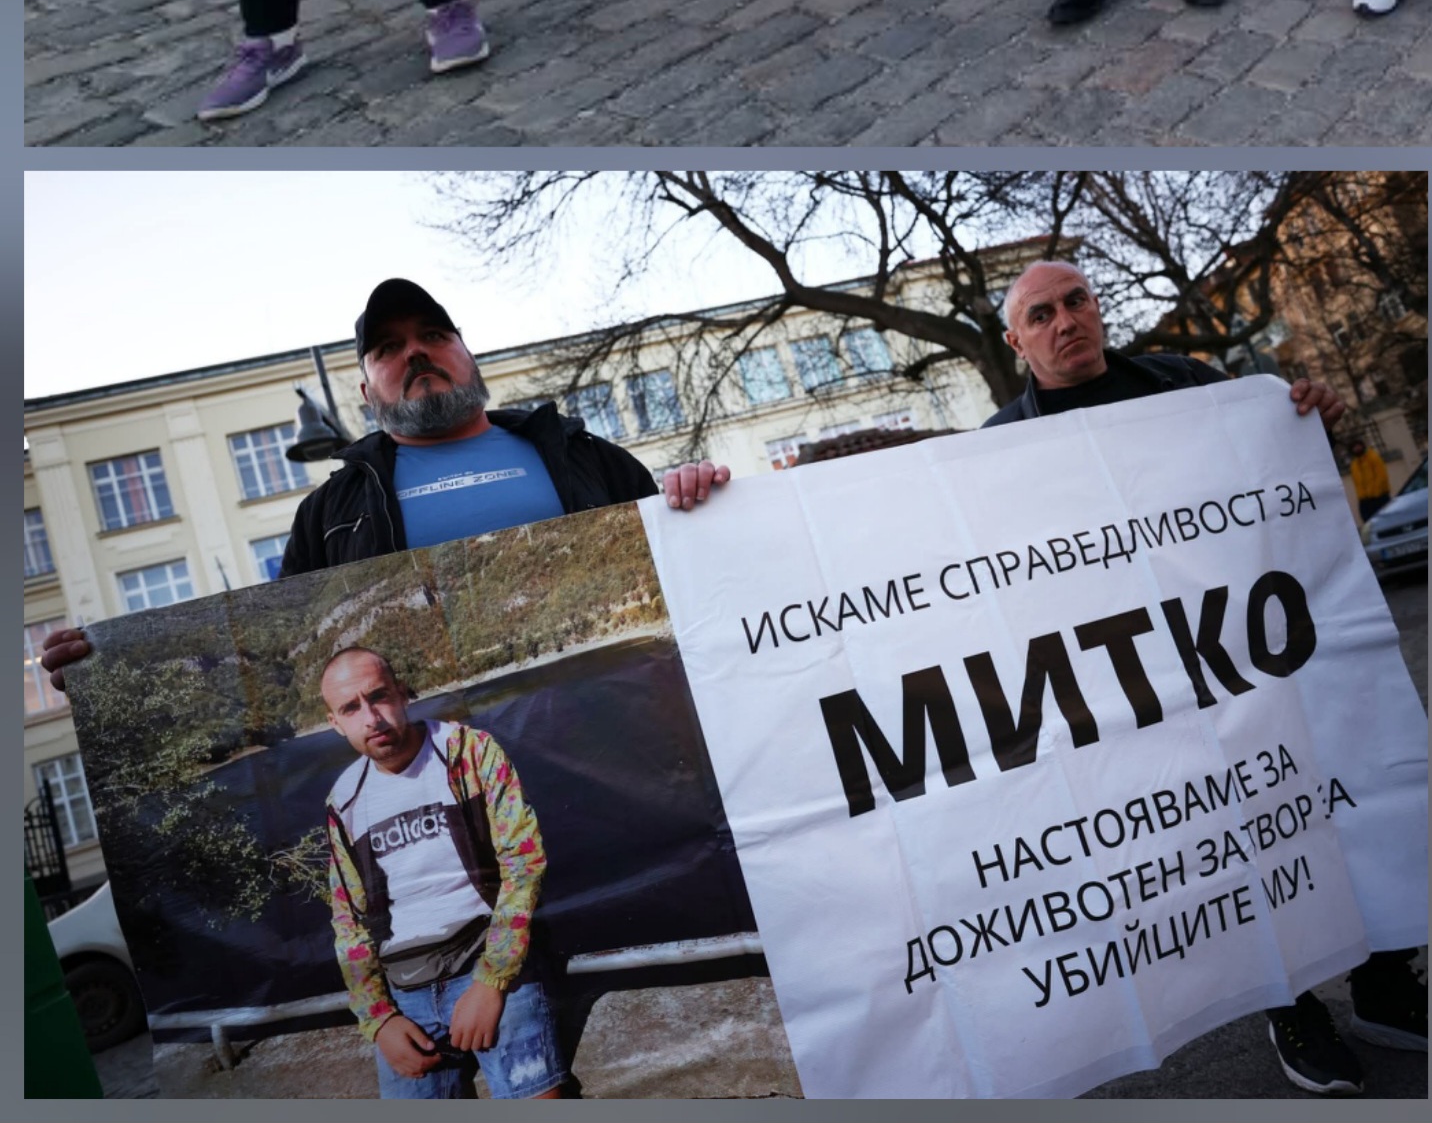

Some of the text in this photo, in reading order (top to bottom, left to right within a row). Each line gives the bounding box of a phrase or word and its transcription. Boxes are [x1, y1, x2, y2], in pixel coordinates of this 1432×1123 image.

[473, 469, 520, 484] ZONE
[740, 480, 1318, 655] ИСКАМЕ СПРАВЕДЛИВОСТ ЗА
[818, 569, 1318, 818] МИТКО
[903, 850, 1187, 995] ДОЖИВОТЕН
[1195, 794, 1313, 878] ЗАТВОР
[971, 742, 1299, 888] НАСТОЯВАМЕ ЗА
[1021, 884, 1257, 1009] УБИЙЦИТЕ
